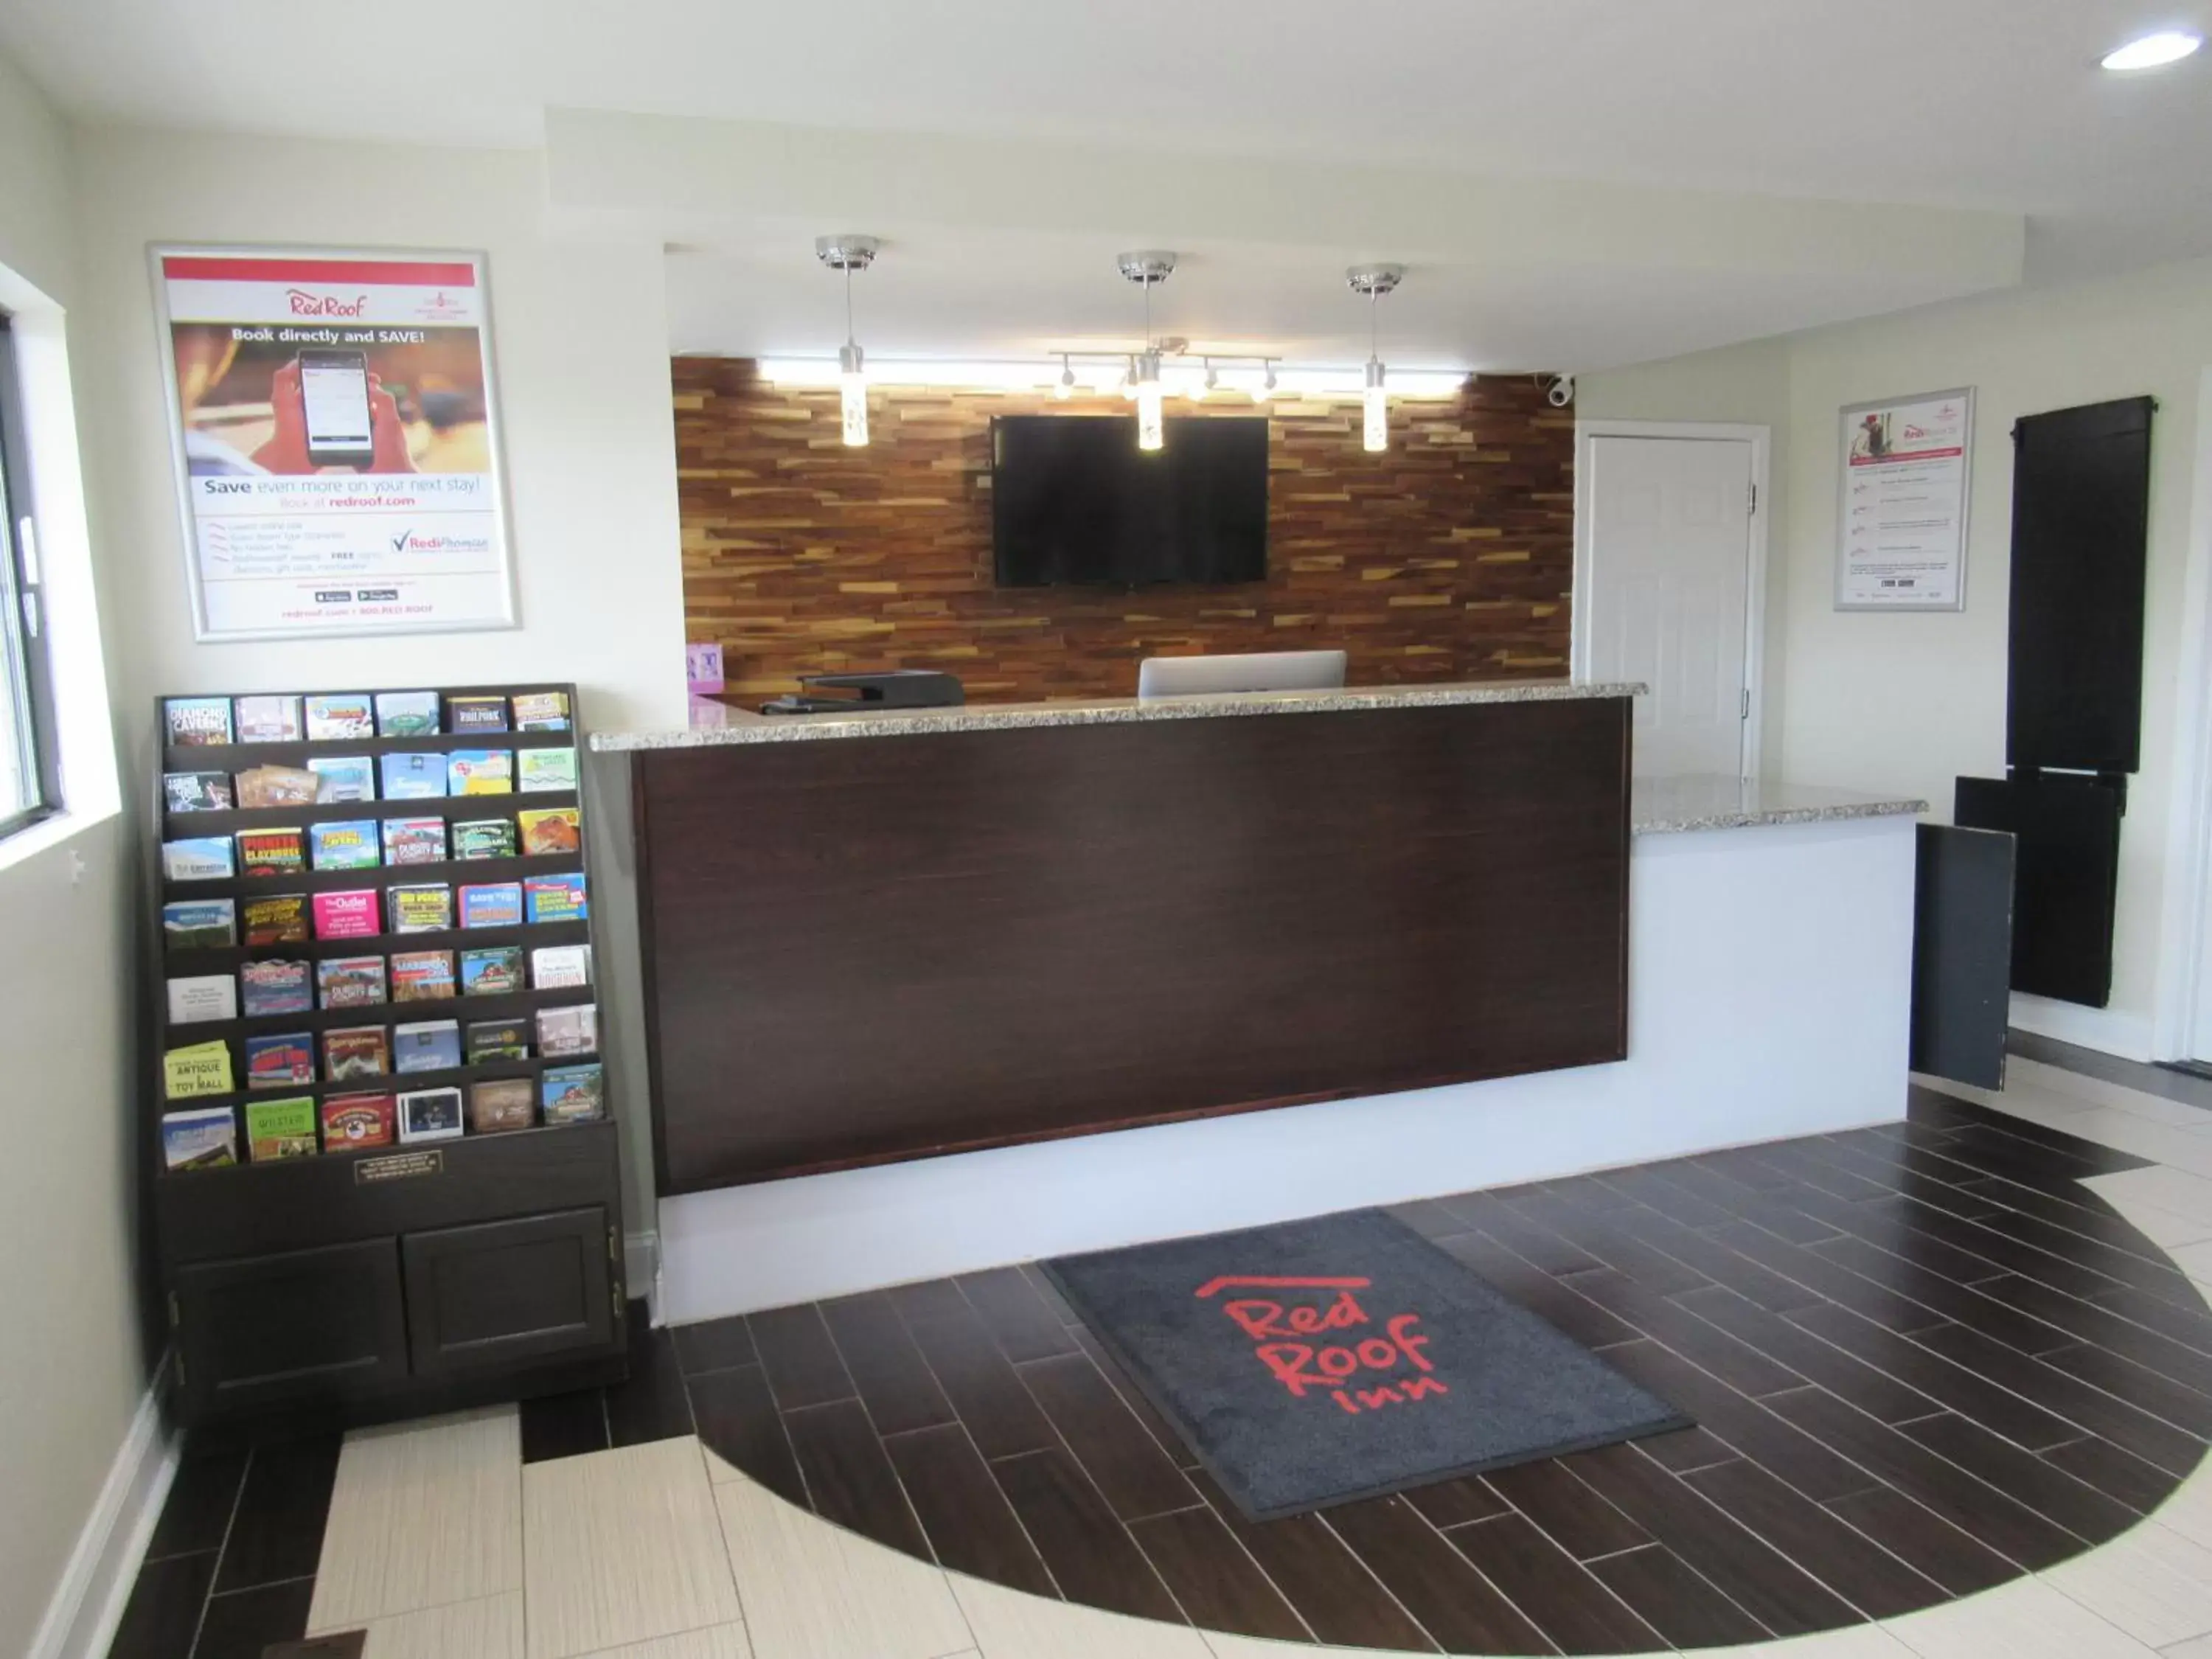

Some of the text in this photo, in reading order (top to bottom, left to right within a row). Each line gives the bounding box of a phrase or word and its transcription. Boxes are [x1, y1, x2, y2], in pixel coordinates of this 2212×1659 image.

[232, 328, 425, 345] Book directly and SAVE!
[204, 476, 481, 495] Save even more on your next stay!
[280, 497, 309, 509] Book
[329, 496, 415, 508] redroof.com
[335, 897, 367, 909] Outlet
[176, 1062, 222, 1076] ANTIQUE
[176, 1079, 223, 1092] TOY MALL
[1222, 1290, 1371, 1340] Red
[1256, 1313, 1436, 1397] Roof
